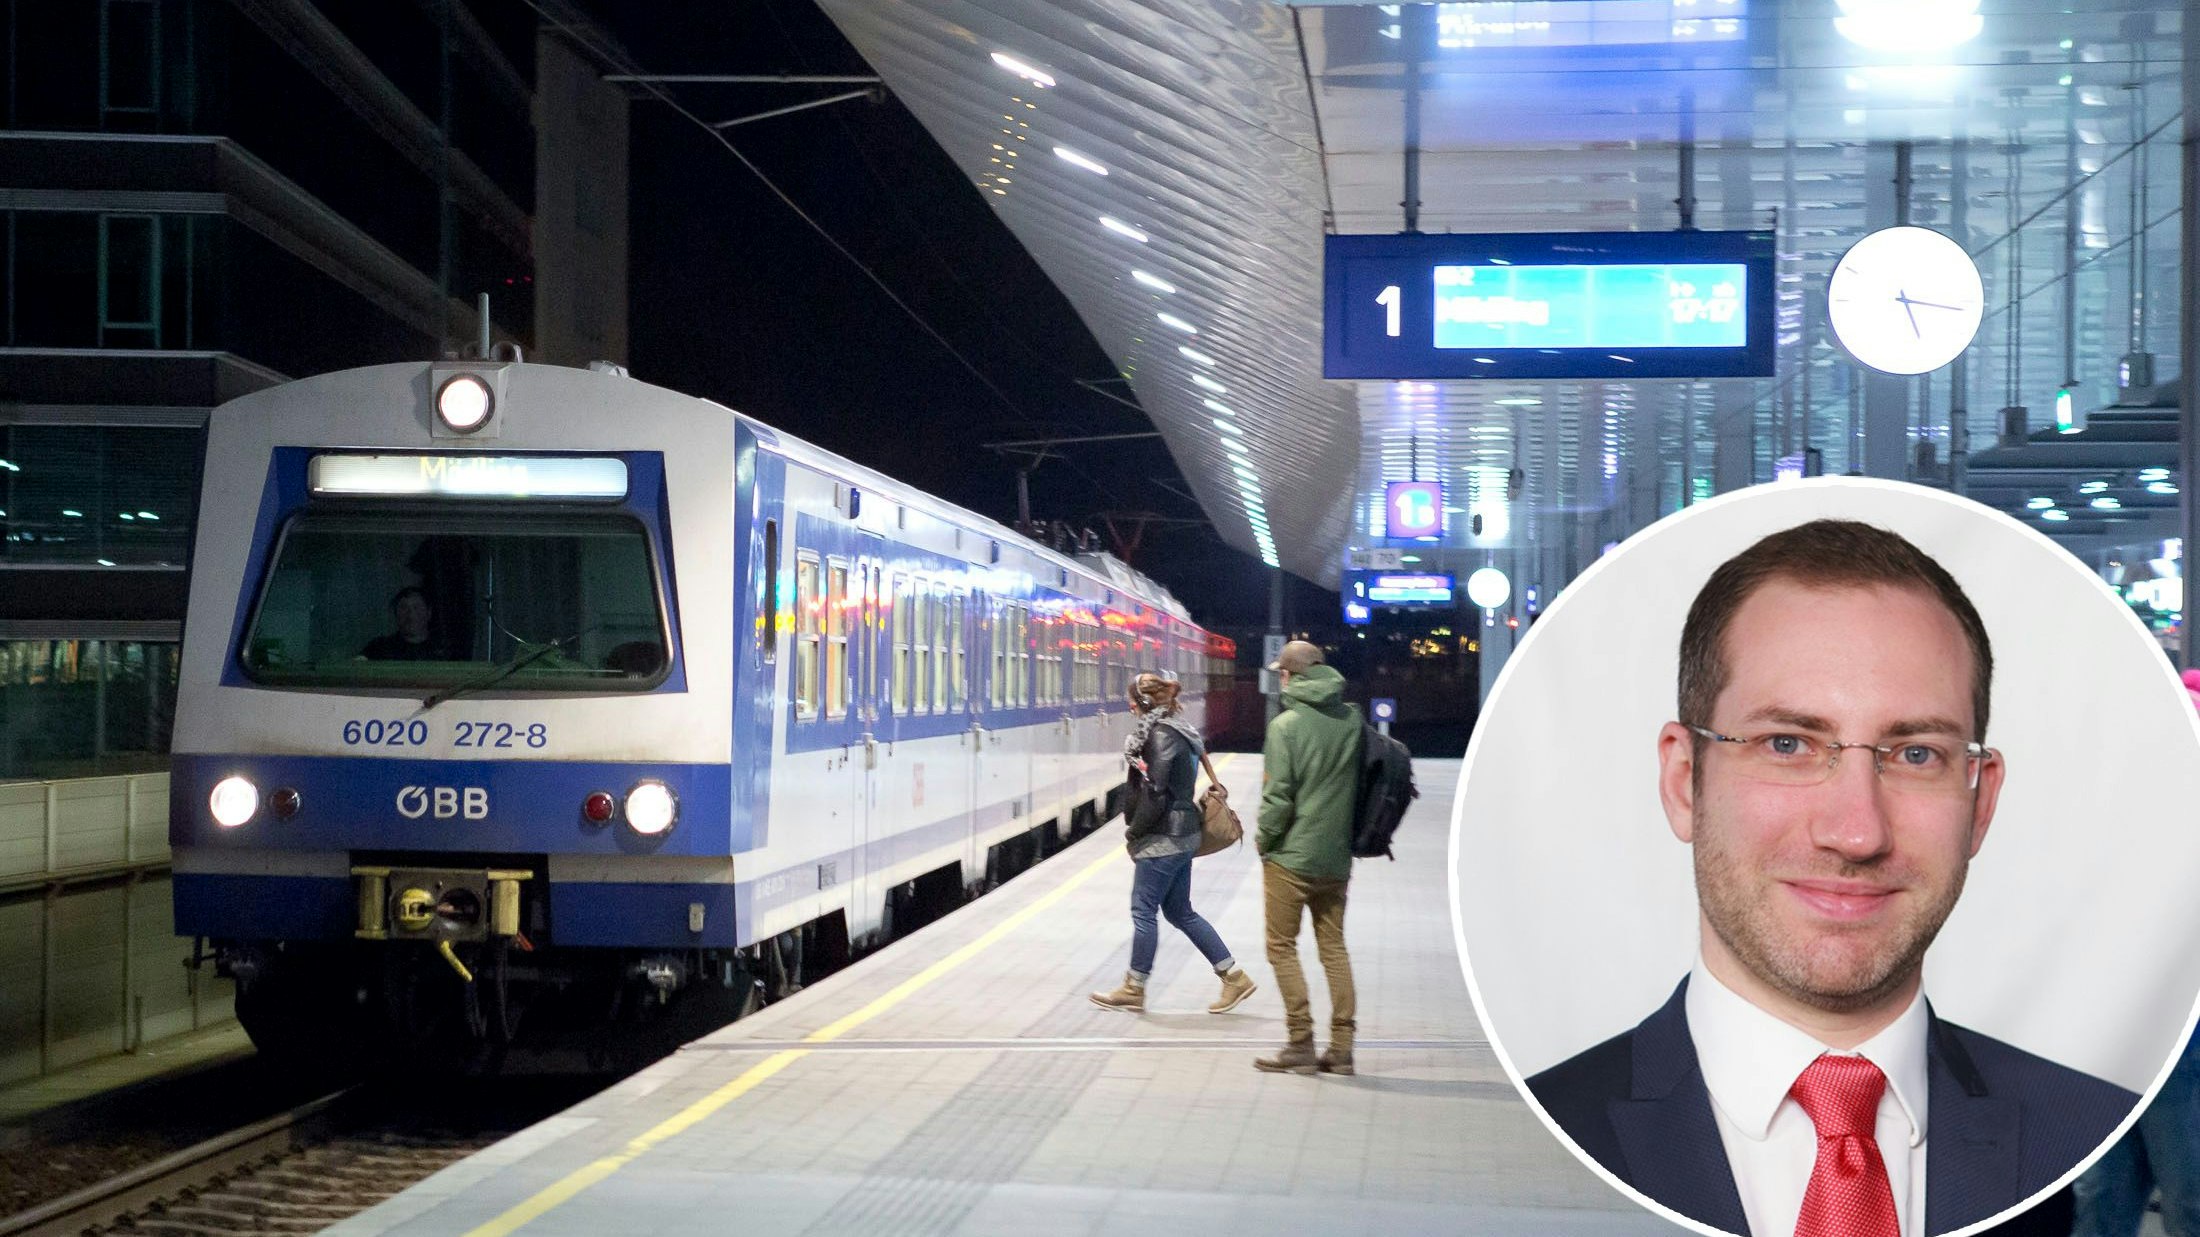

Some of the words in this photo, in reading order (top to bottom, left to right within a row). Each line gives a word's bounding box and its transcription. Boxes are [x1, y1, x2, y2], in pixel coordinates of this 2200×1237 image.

[1375, 285, 1401, 337] 1
[343, 719, 428, 745] 6020
[454, 721, 547, 748] 272-8
[396, 785, 489, 819] ÖBB
